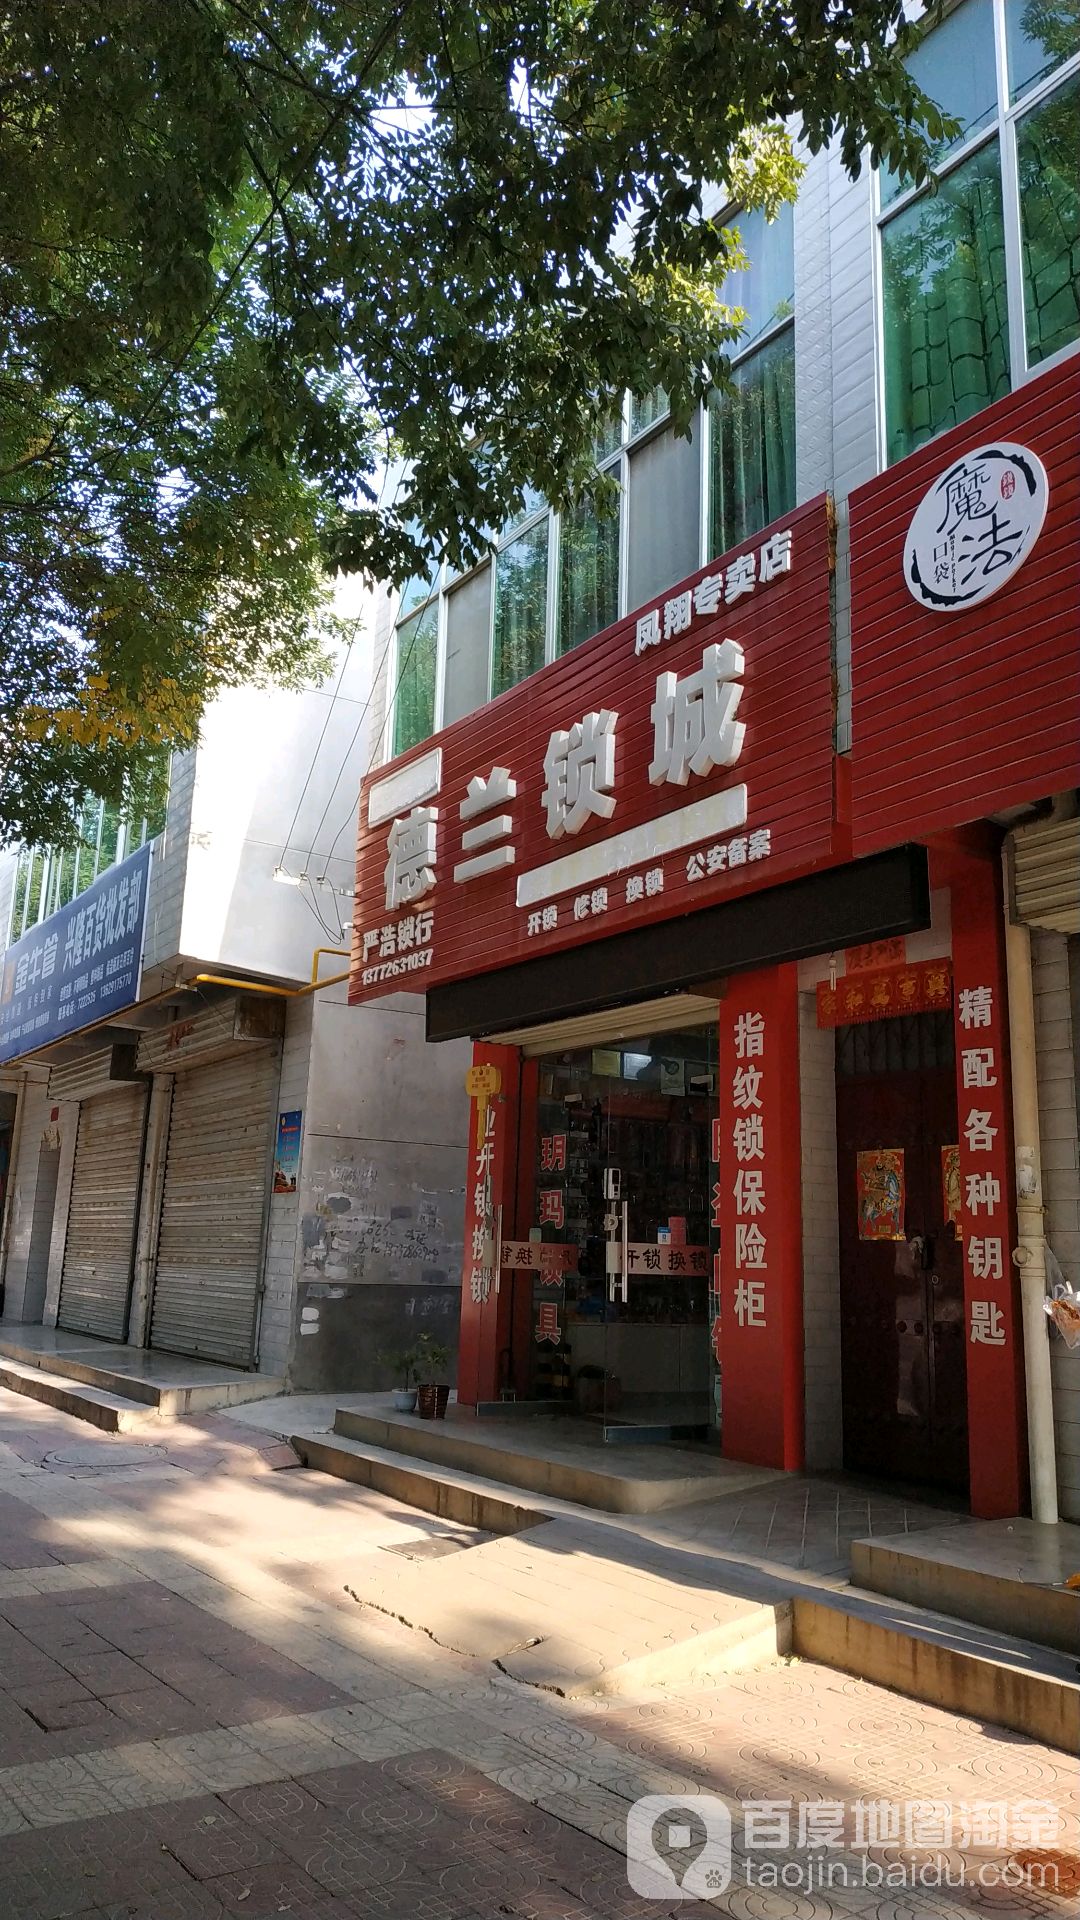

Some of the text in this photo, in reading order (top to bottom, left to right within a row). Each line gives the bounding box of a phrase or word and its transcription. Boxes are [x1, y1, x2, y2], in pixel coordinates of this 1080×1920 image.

[936, 463, 1023, 586] 魔法
[634, 529, 793, 657] 凤翔专卖店
[383, 638, 747, 912] 德兰锁城
[362, 910, 435, 963] 严浩锁行
[527, 828, 772, 936] 开锁 修锁 换锁 公安备案
[361, 948, 434, 986] 13772631037
[732, 1011, 769, 1328] 指纹锁保险柜
[958, 985, 1007, 1347] 精配各种钥匙
